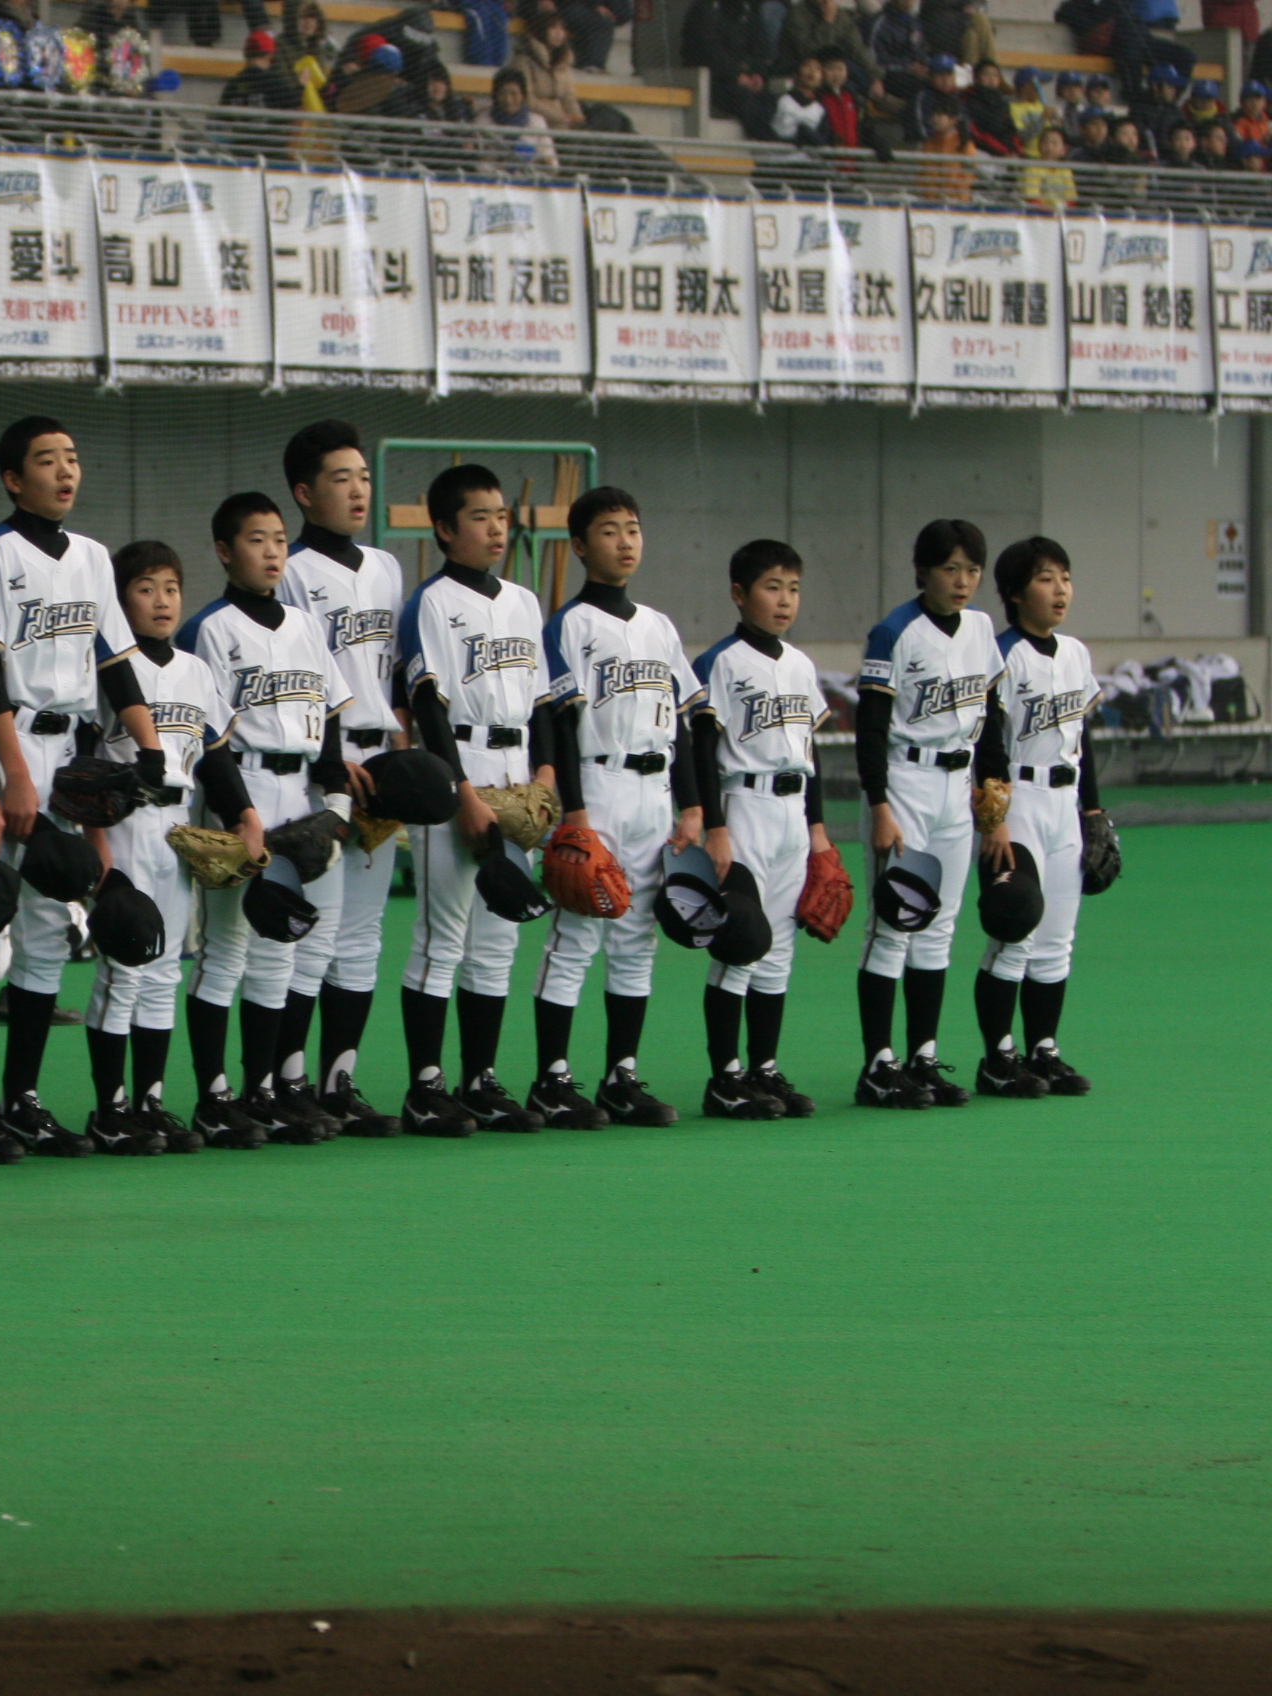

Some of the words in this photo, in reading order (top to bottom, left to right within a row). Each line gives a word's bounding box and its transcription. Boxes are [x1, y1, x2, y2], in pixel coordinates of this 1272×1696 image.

[10, 228, 79, 283] 愛斗
[103, 233, 180, 287] 高山
[275, 247, 340, 296] 二川
[435, 253, 495, 303] 布施
[596, 263, 662, 311] 山田
[676, 267, 741, 316] 翔太
[916, 277, 991, 323] 久保山
[11, 598, 98, 651] FIGHTE
[326, 606, 393, 656] FIGHTE
[376, 652, 394, 682] 13
[653, 700, 671, 730] 15
[738, 691, 810, 742] FIGHTE
[908, 676, 987, 724] FIGHTE
[304, 713, 322, 742] 12
